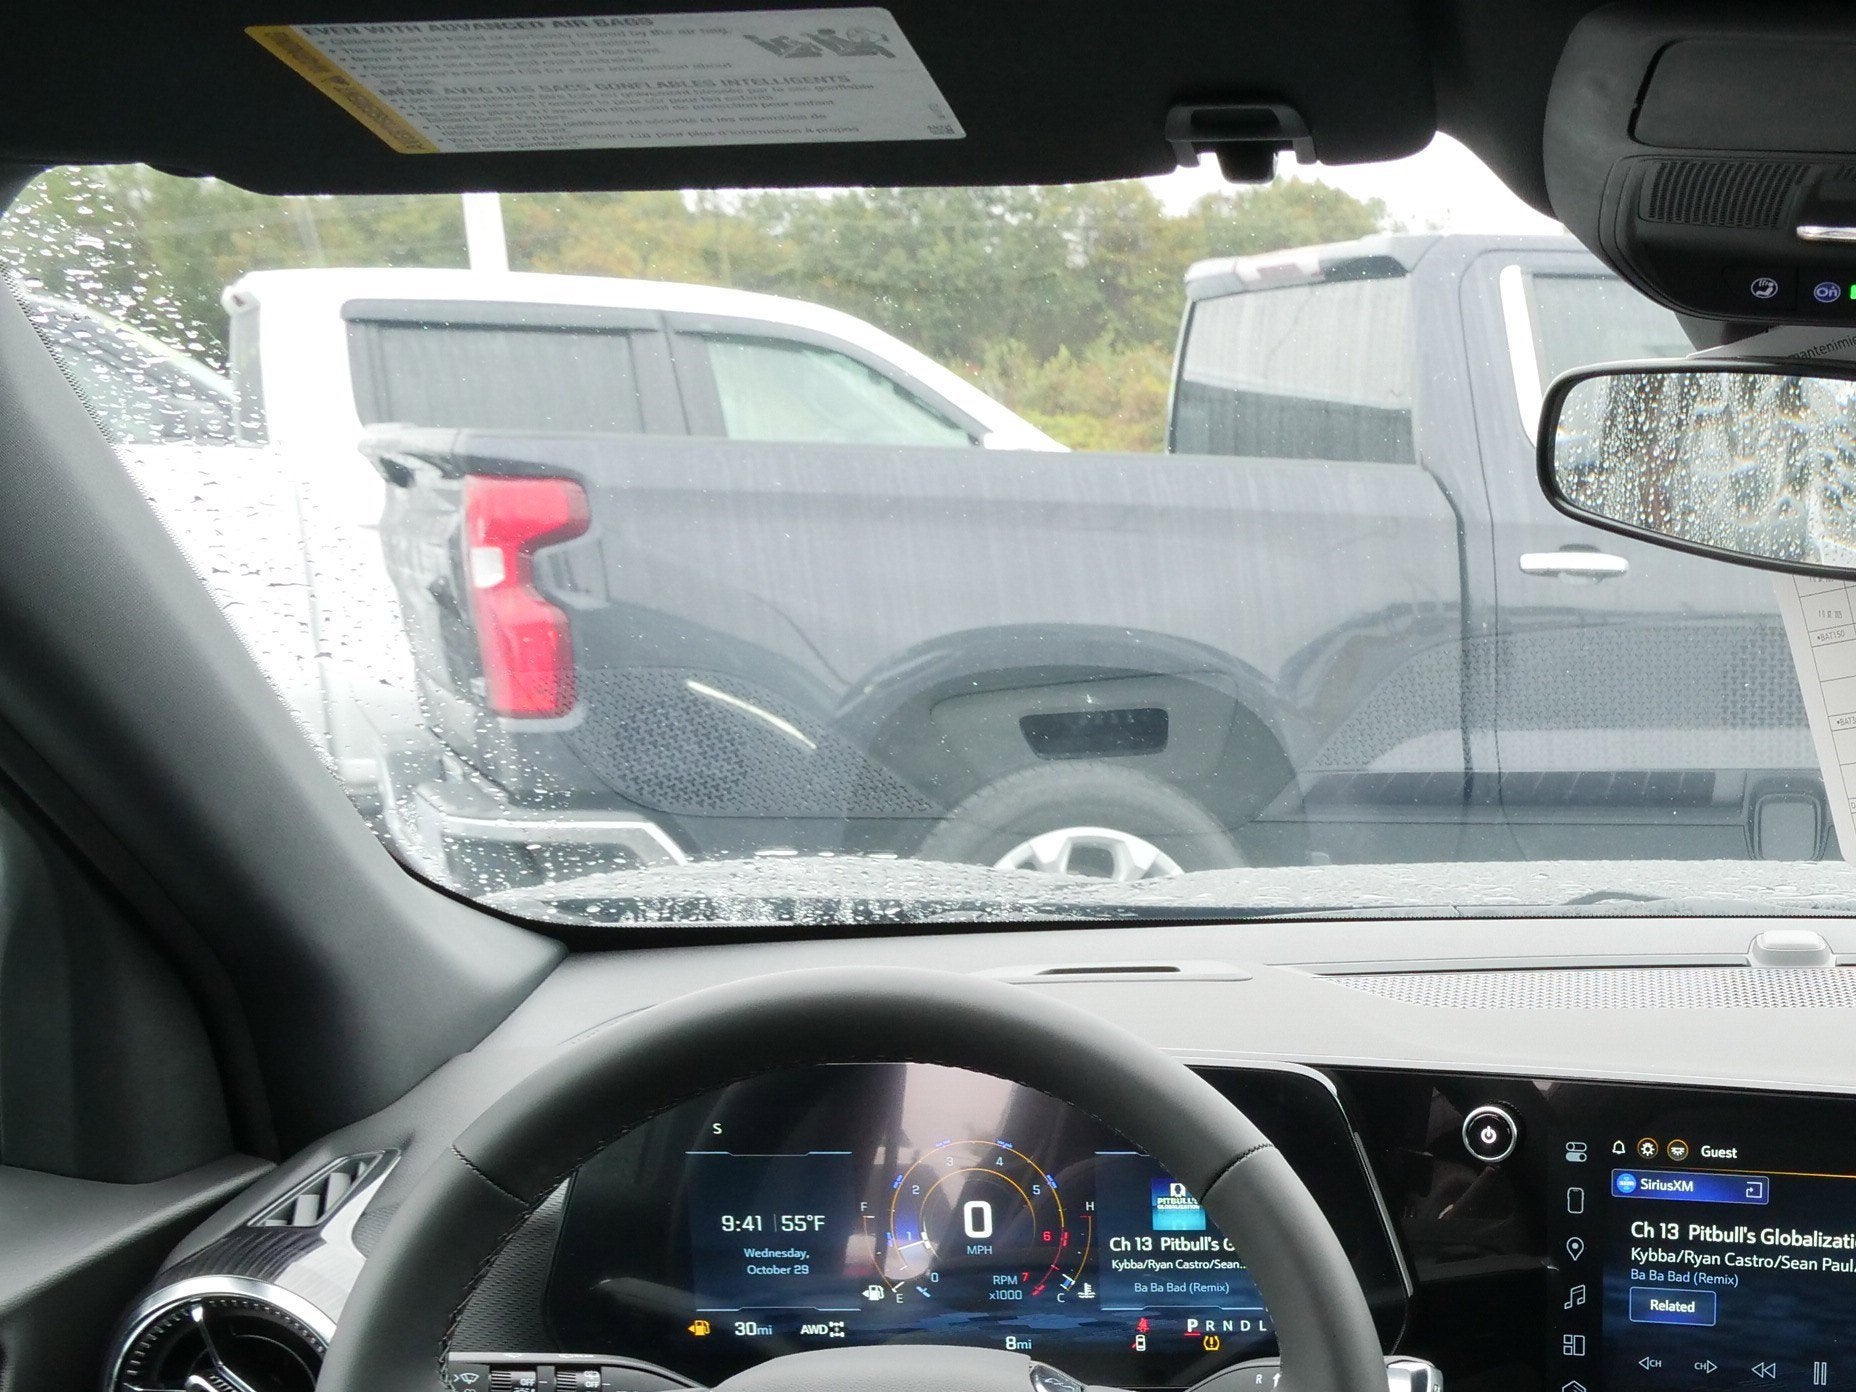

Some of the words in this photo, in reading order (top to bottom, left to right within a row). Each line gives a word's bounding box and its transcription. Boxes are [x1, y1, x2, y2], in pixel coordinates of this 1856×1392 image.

[713, 1123, 722, 1135] S
[1701, 1146, 1738, 1158] Guest
[946, 1157, 954, 1166] 3
[995, 1157, 1004, 1167] 4
[912, 1185, 920, 1195] 2
[1033, 1184, 1041, 1195] 5
[1640, 1178, 1694, 1192] SiriusXM
[861, 1202, 868, 1211] F
[1086, 1201, 1094, 1211] H
[721, 1215, 763, 1232] 9:41
[781, 1214, 826, 1232] 55°F
[964, 1200, 994, 1239] 0
[1043, 1231, 1051, 1241] 6
[1631, 1221, 1654, 1239] Ch
[1660, 1222, 1680, 1240] 13
[1689, 1224, 1757, 1245] Pitbull's
[1110, 1237, 1130, 1252] Ch
[1134, 1237, 1153, 1252] 13
[1160, 1236, 1219, 1252] Pitbull's
[744, 1248, 811, 1260] Wednesday,
[967, 1245, 993, 1255] MPH
[1112, 1259, 1173, 1271] Kybba/Ryan
[1631, 1247, 1720, 1268] Kybba/Ryan
[1724, 1252, 1818, 1272] Castro/Sean
[747, 1264, 792, 1275] October
[793, 1264, 810, 1276] 29
[931, 1272, 940, 1282] 0
[993, 1275, 1019, 1285] RPM
[1022, 1272, 1030, 1282] 7
[1631, 1269, 1646, 1280] Ba
[1649, 1270, 1664, 1281] Ba
[1668, 1270, 1690, 1283] Bad
[1694, 1272, 1739, 1288] (Remix)
[1134, 1282, 1148, 1293] Ba
[1151, 1282, 1164, 1293] Ba
[1166, 1282, 1187, 1293] Bad
[1189, 1282, 1230, 1295] (Remix)
[897, 1293, 904, 1303] E
[989, 1290, 1022, 1300] x1000
[1057, 1292, 1065, 1303] C
[1650, 1299, 1696, 1313] Related
[800, 1324, 829, 1335] AWD
[1187, 1318, 1198, 1332] P
[1206, 1321, 1215, 1331] R
[1223, 1321, 1233, 1331] N
[1241, 1321, 1250, 1331] D
[1260, 1321, 1267, 1331] L
[1650, 1360, 1662, 1369] CH
[1694, 1362, 1707, 1371] CH
[520, 1378, 536, 1387] OFF
[1255, 1374, 1263, 1384] R
[585, 1381, 600, 1389] OFF
